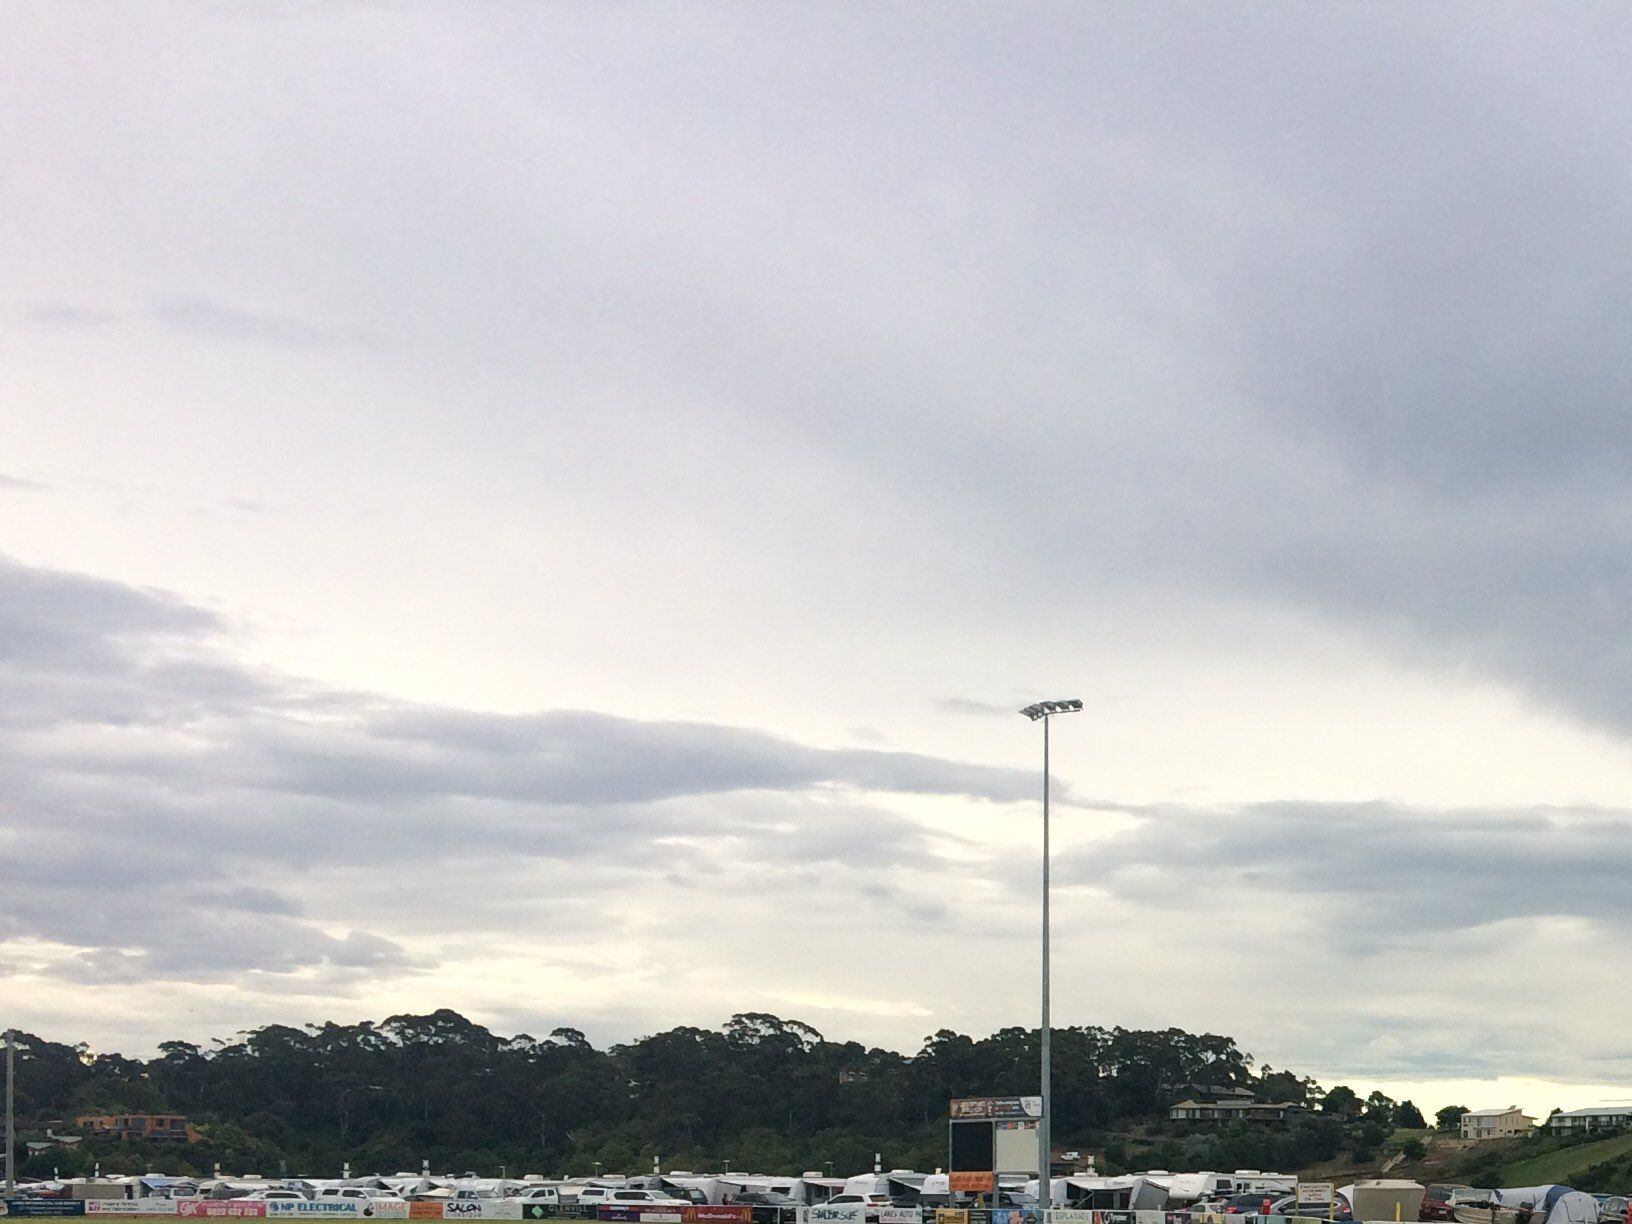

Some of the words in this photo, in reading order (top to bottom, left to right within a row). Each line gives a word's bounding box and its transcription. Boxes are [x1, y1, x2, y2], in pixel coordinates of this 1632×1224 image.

[298, 1203, 357, 1212] ELECTRICAL
[374, 1202, 406, 1211] IMAGE
[446, 1202, 482, 1213] SALON
